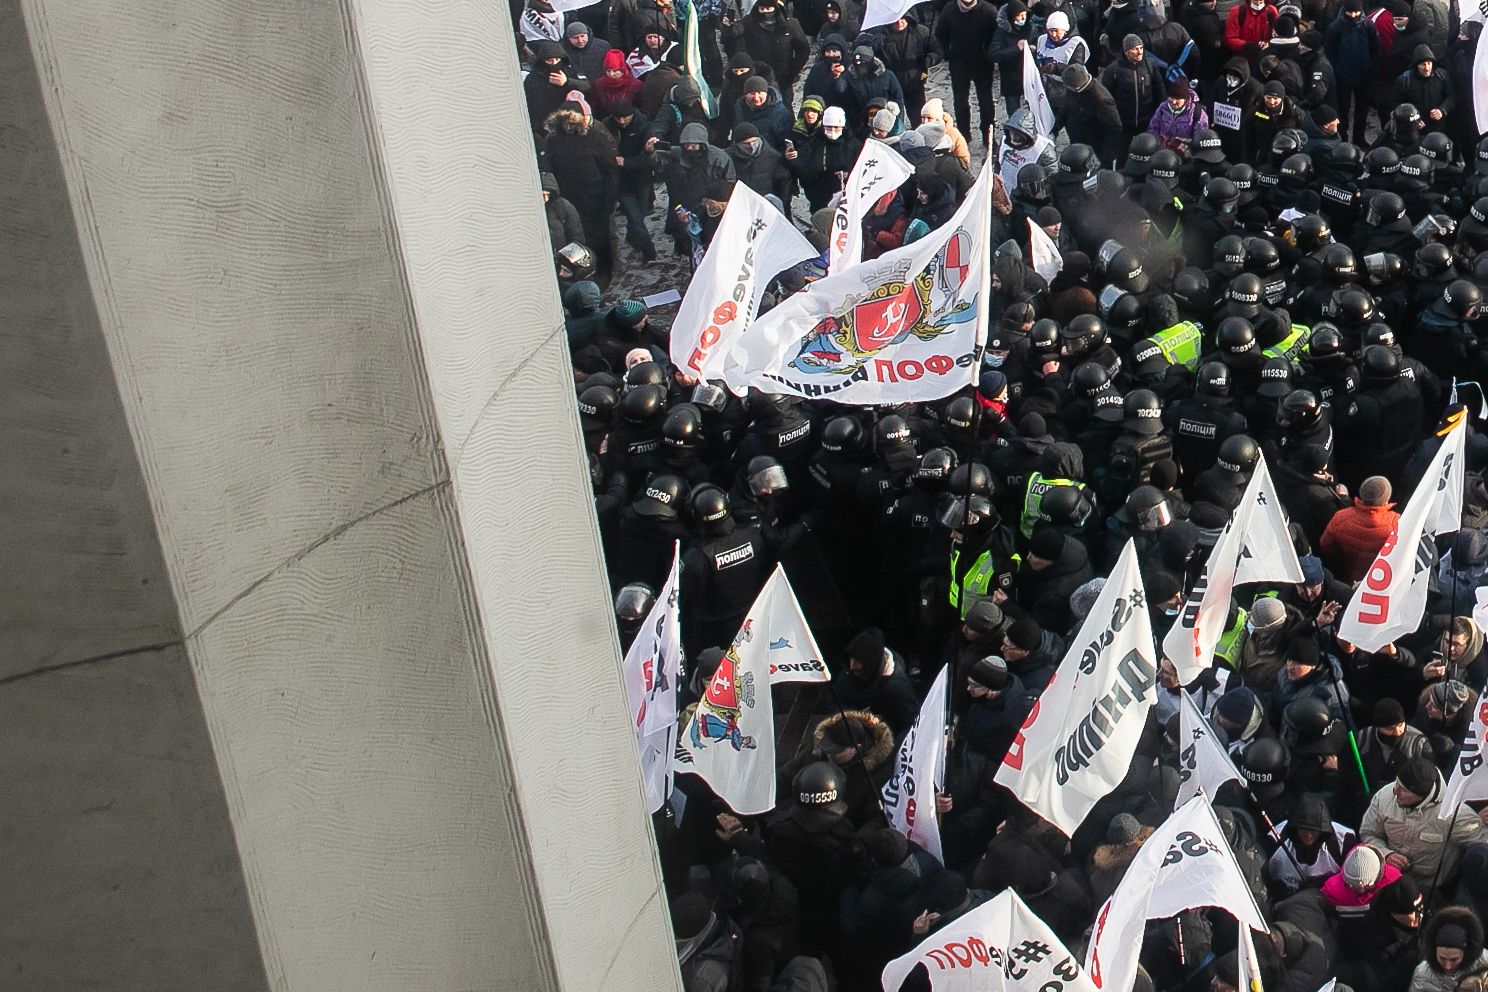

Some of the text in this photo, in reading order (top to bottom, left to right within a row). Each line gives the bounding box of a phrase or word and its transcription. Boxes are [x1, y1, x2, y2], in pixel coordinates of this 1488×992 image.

[1324, 186, 1352, 204] ПОЛІЦІЯ
[1180, 421, 1215, 438] ПОЛІЦІЯ
[717, 546, 752, 566] ПОЛІЦІЯ
[800, 790, 837, 803] 0915530
